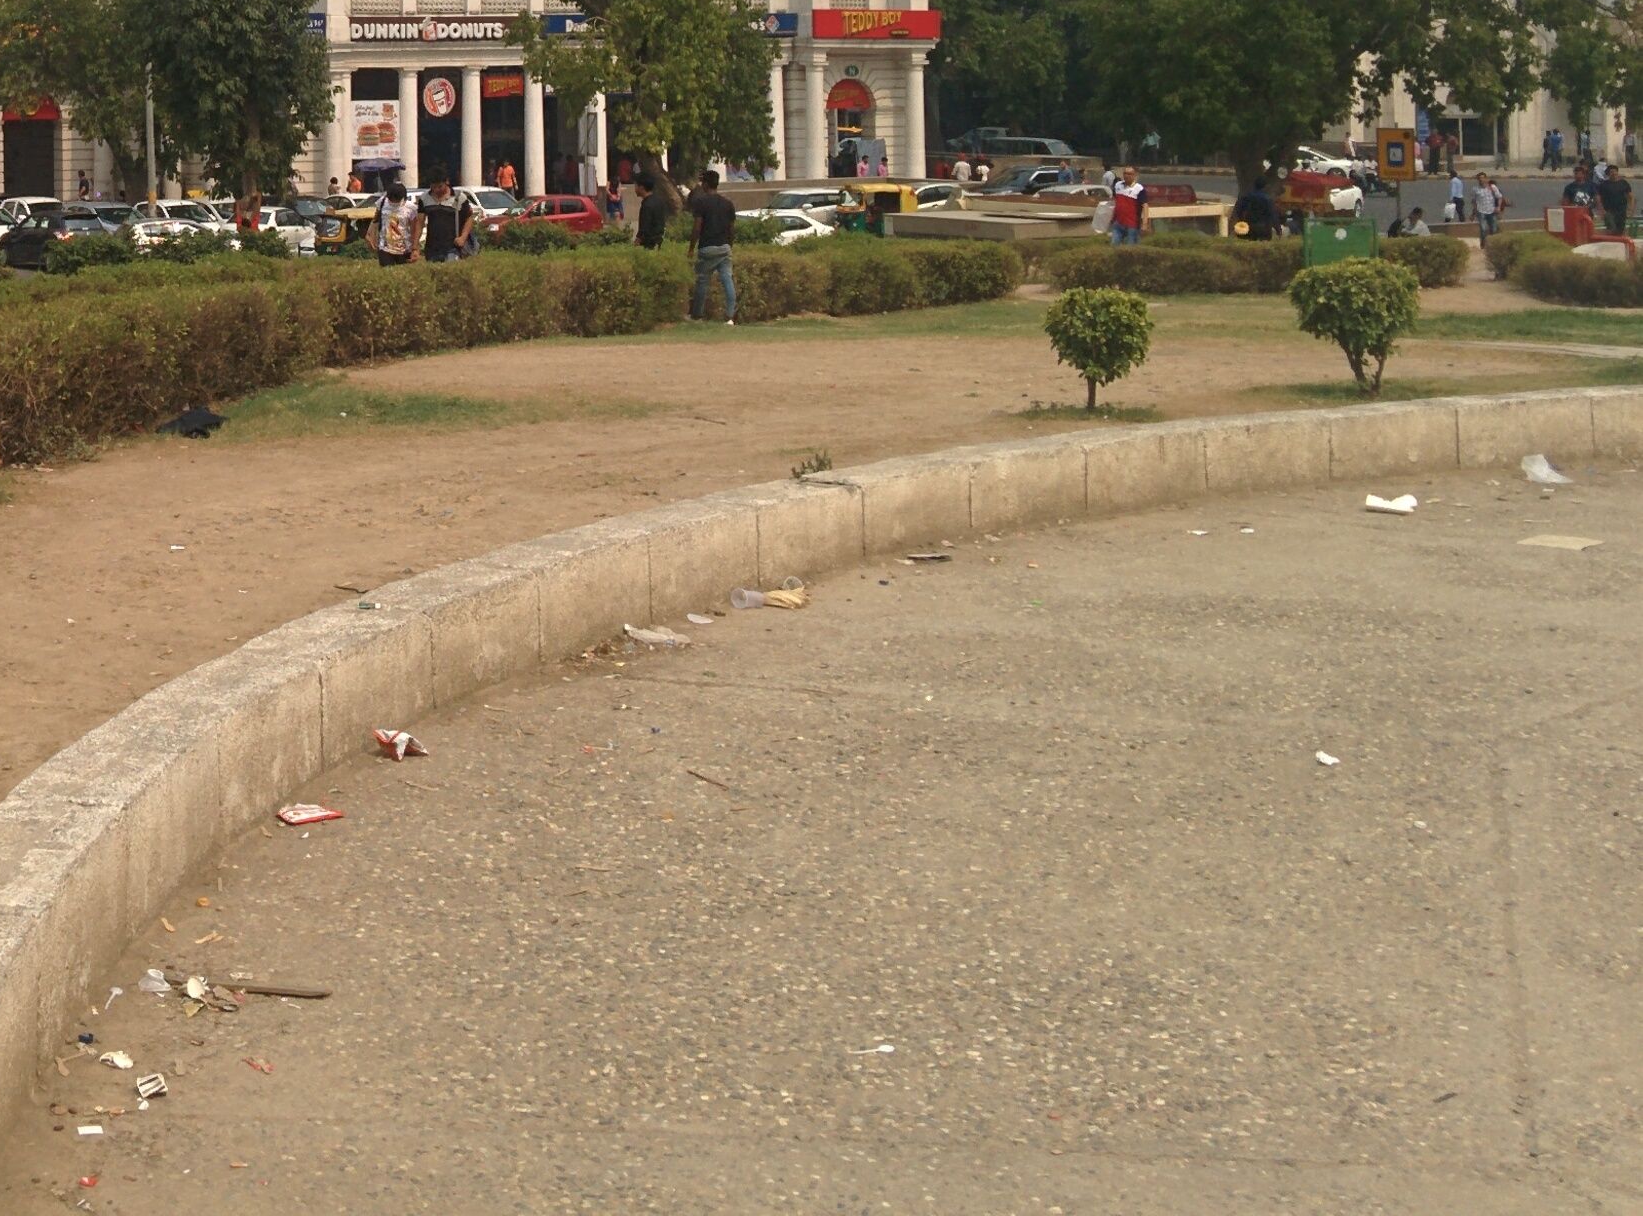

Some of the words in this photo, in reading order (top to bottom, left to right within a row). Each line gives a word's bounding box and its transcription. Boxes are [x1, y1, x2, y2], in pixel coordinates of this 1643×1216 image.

[437, 22, 504, 39] DONUTS
[842, 11, 879, 36] TEDDY
[881, 11, 902, 26] BOY
